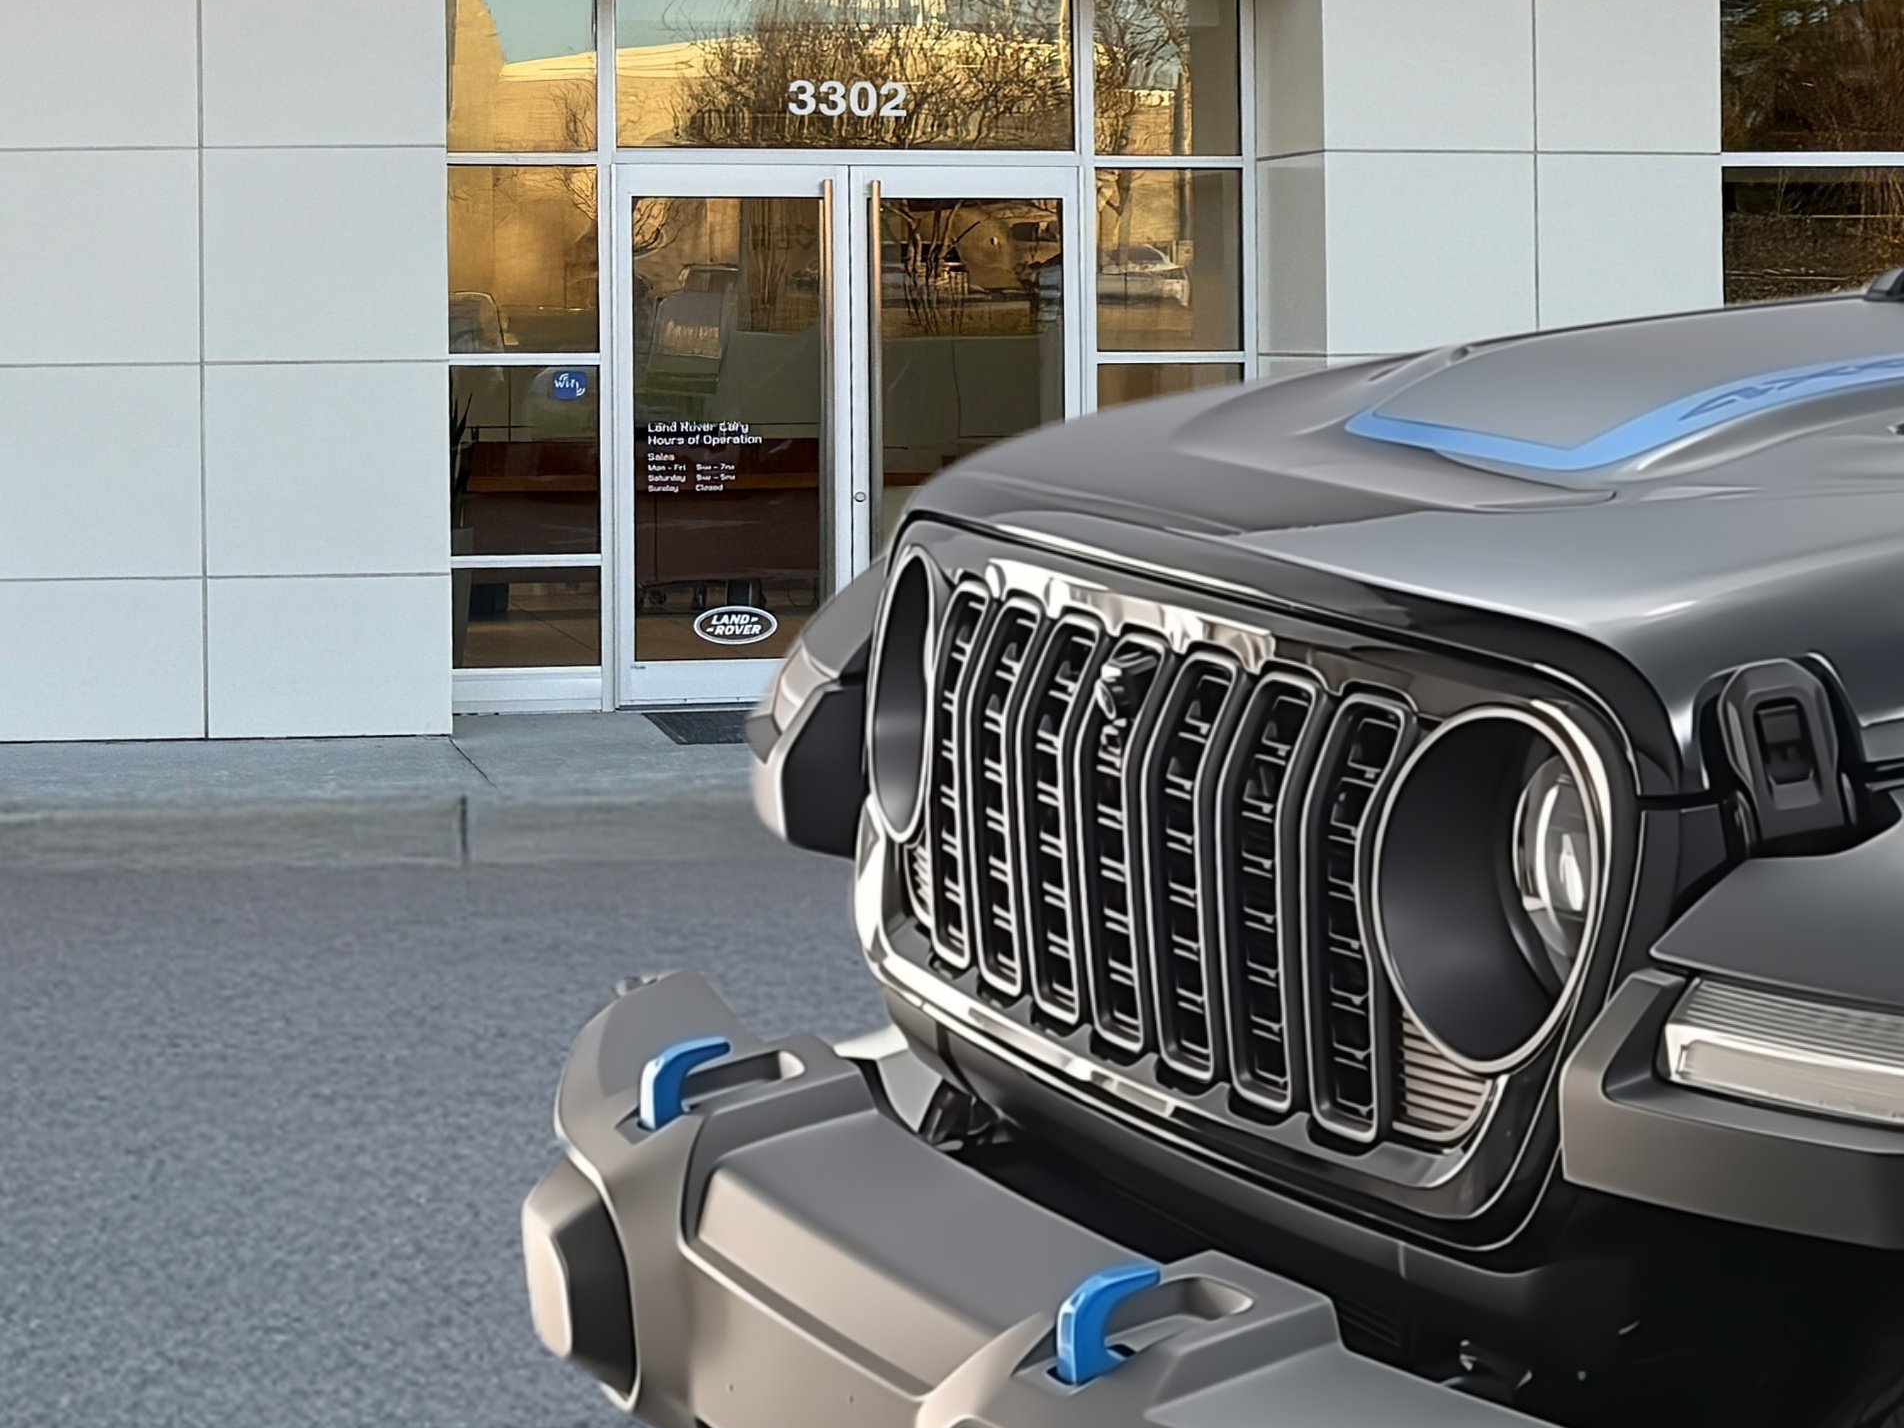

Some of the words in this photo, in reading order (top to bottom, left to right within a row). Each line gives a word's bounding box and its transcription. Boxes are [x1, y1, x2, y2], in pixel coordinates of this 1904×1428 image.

[786, 78, 908, 119] 3302
[647, 421, 677, 433] Land
[680, 421, 717, 433] Rover
[647, 435, 685, 445] Hours
[687, 434, 700, 445] of
[703, 434, 763, 446] Operation
[647, 452, 676, 462] Sales
[647, 474, 686, 483] Saturday
[647, 484, 679, 493] Sunday
[711, 614, 751, 625] LAND
[714, 624, 762, 636] ROVER
